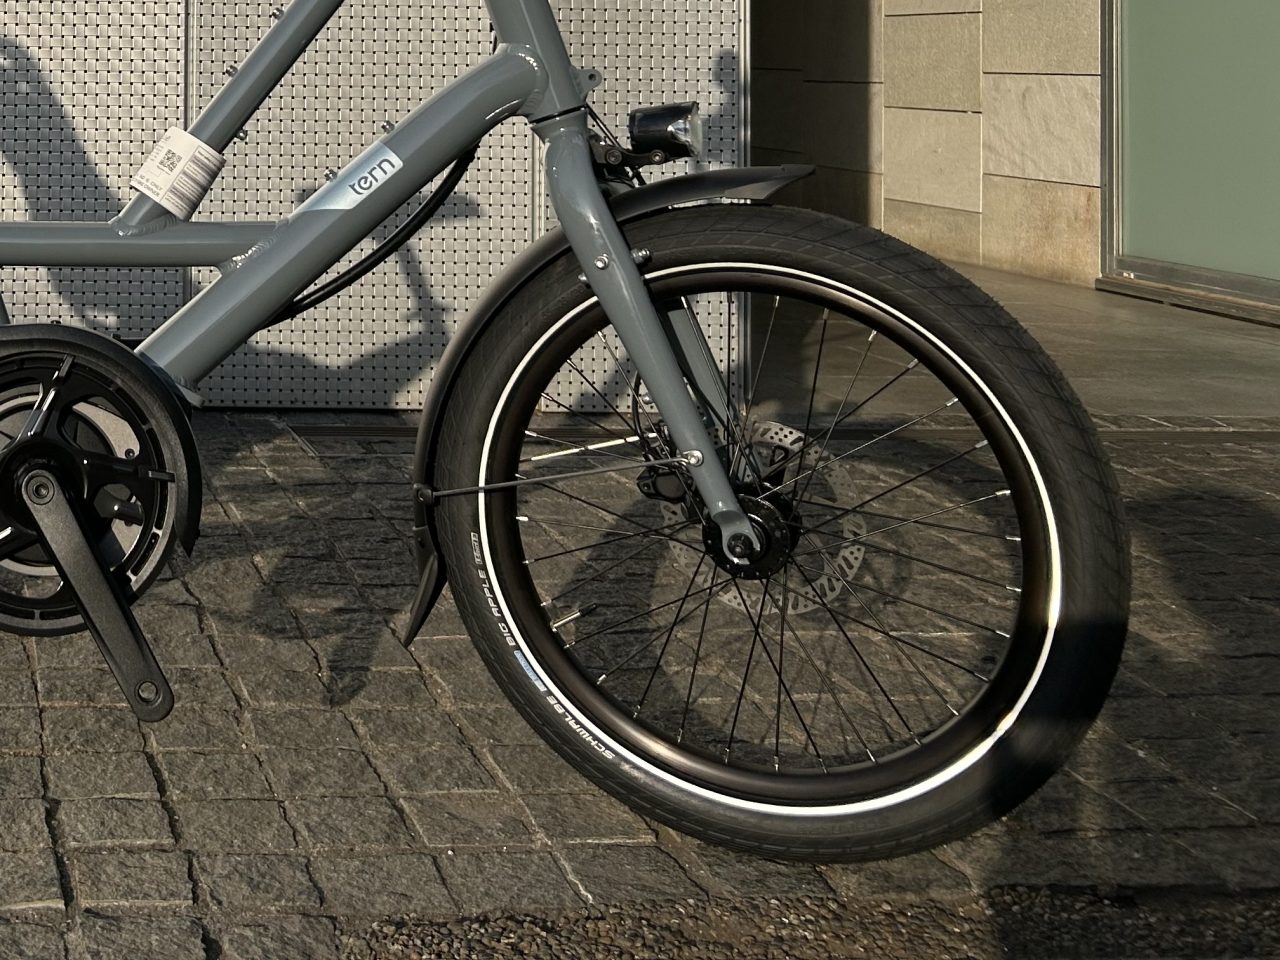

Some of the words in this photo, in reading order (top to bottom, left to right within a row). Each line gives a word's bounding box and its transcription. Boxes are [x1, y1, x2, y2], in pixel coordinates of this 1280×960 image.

[348, 155, 396, 196] tern
[478, 568, 502, 618] APPLE
[498, 622, 516, 647] BIG
[545, 694, 617, 760] SCHWALBE
